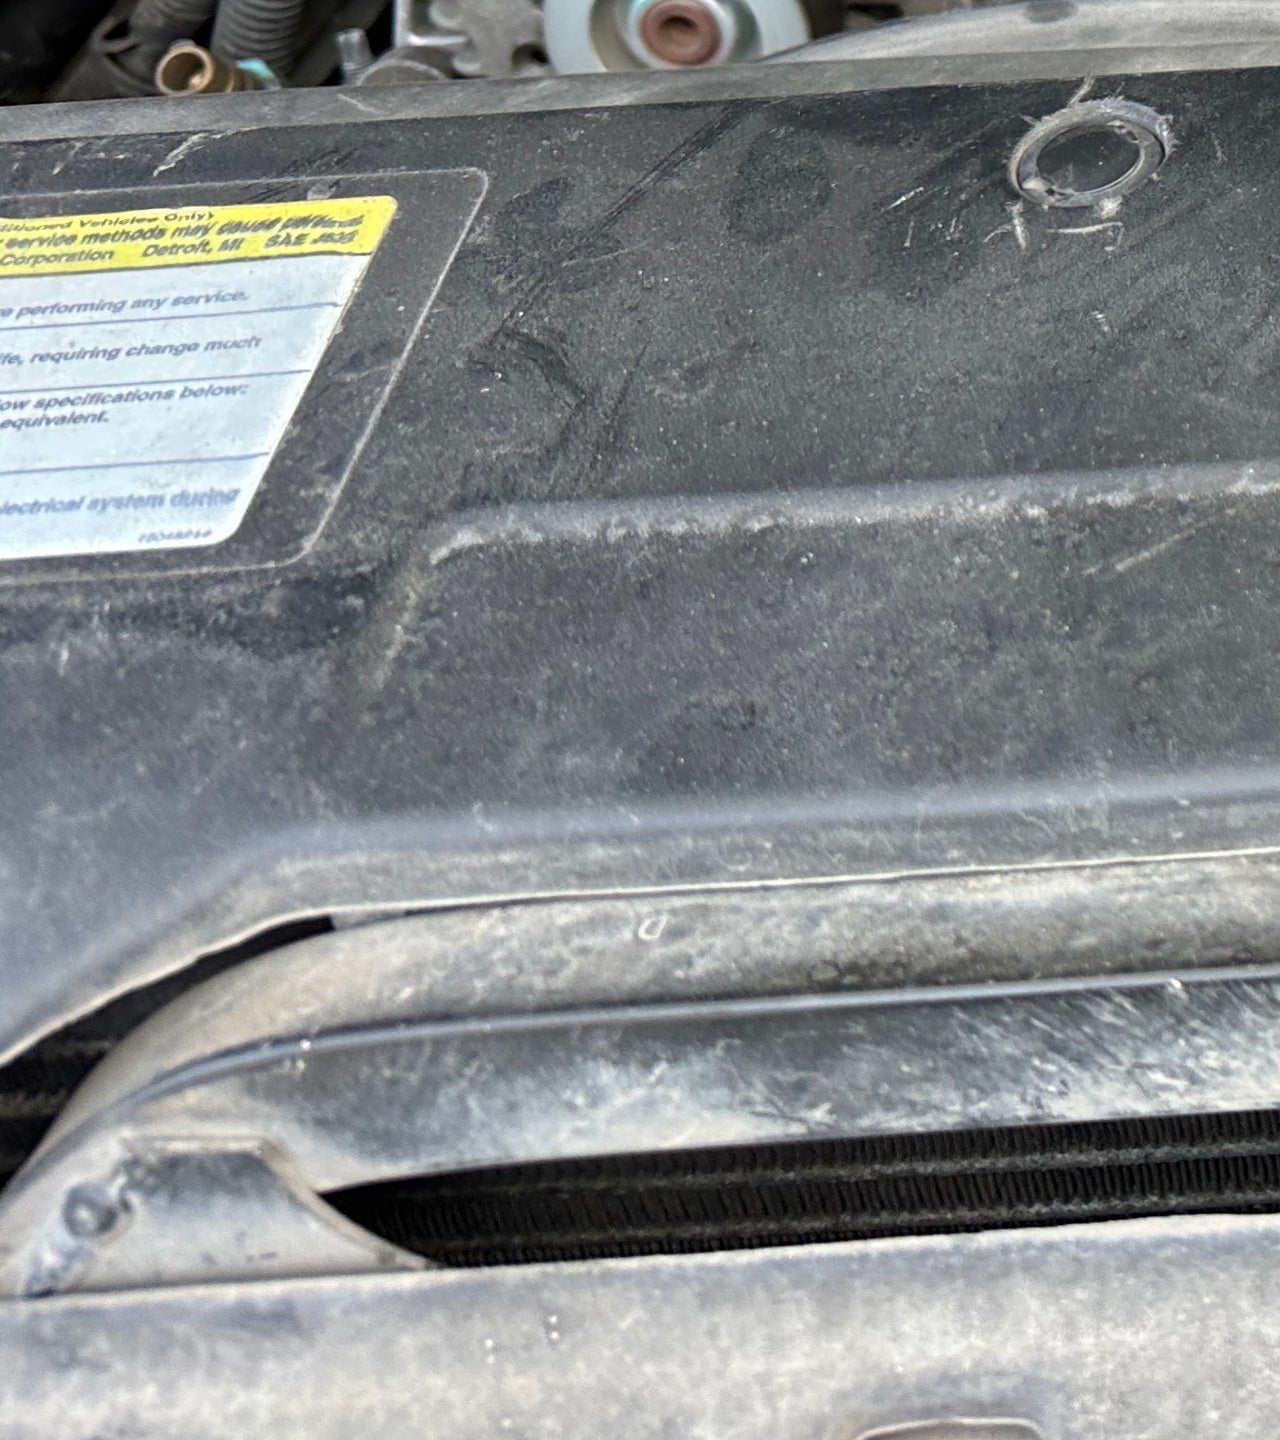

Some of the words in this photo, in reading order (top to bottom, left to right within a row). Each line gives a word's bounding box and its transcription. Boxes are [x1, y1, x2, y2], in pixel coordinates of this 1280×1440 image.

[80, 216, 159, 227] Vehicles
[164, 211, 214, 222] Only)
[5, 232, 78, 249] service
[81, 225, 168, 245] methods
[170, 221, 217, 239] may
[0, 249, 116, 267] Corporation
[141, 238, 213, 258] Detroit,
[217, 238, 245, 253] MI
[264, 232, 309, 248] SAE
[16, 298, 127, 319] performing
[131, 296, 170, 311] any
[171, 290, 249, 306] service.
[30, 347, 122, 364] requiring
[126, 340, 200, 356] change
[34, 387, 175, 410] specifications
[179, 383, 250, 399] below:
[0, 411, 109, 431] equivalent.
[87, 493, 165, 512] system
[170, 486, 241, 507] during
